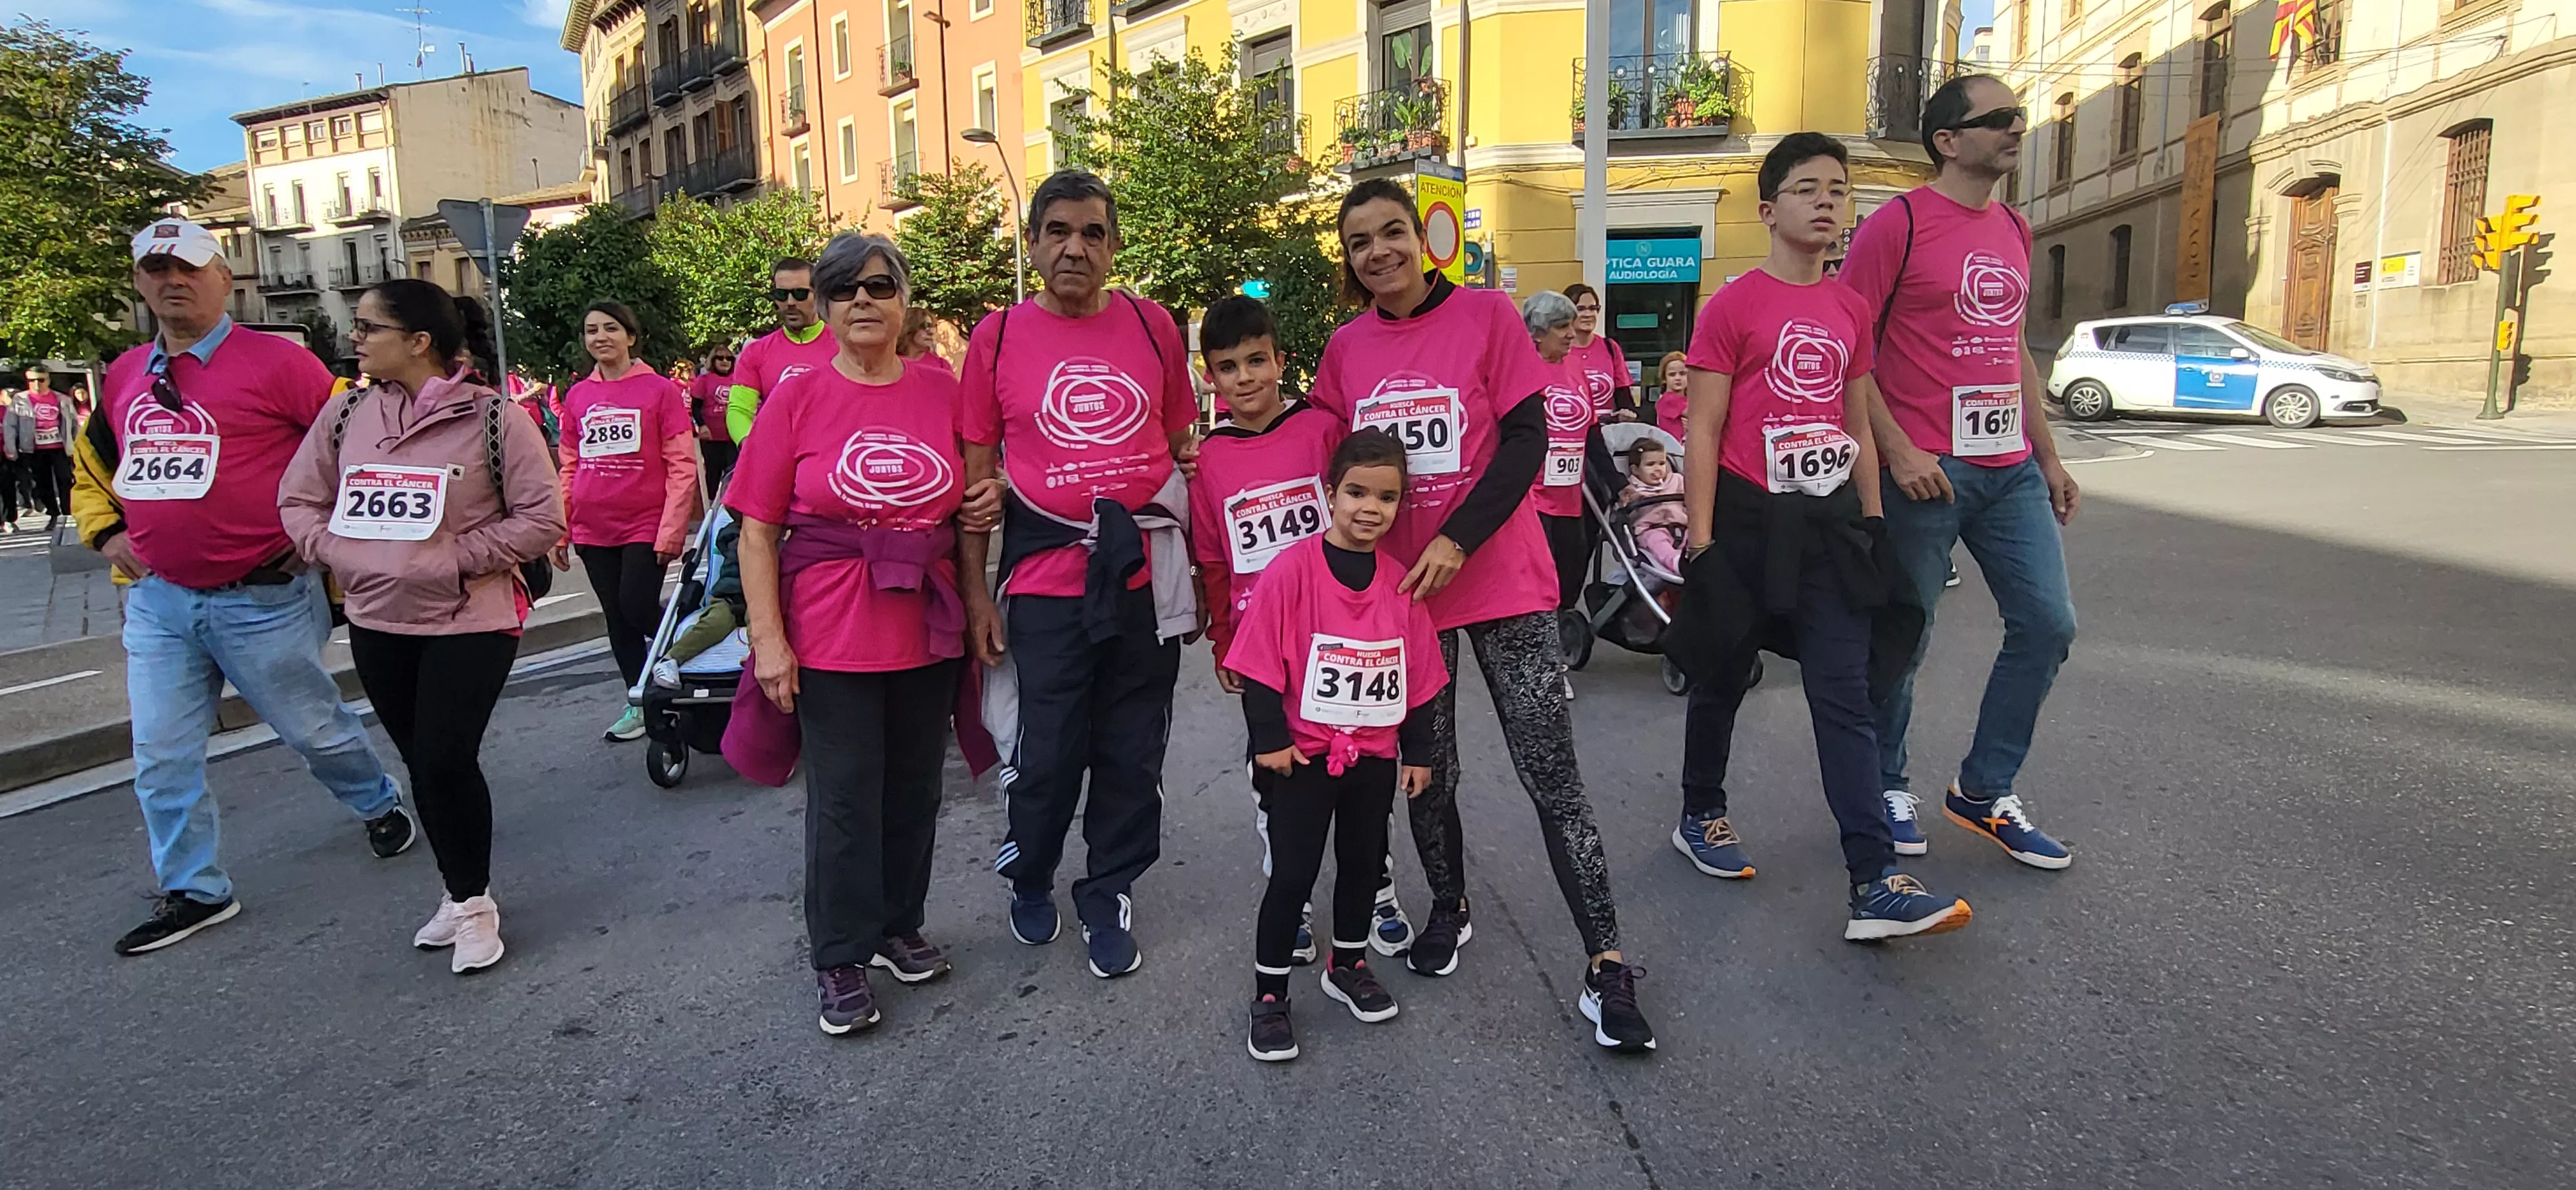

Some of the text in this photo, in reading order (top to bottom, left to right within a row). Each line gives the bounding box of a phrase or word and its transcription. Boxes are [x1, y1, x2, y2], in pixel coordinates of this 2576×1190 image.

[1420, 182, 1462, 198] ATENCIÓN
[1605, 256, 1696, 268] TICA GUARA
[1364, 409, 1397, 420] CONTRA
[1410, 404, 1446, 415] CÁNCER
[1965, 408, 2017, 435] 1697
[585, 424, 633, 444] 2886
[1383, 418, 1448, 450] 150
[1779, 439, 1813, 449] CONTRA
[128, 457, 204, 480] 2664
[1557, 457, 1580, 473] 903
[1779, 444, 1851, 478] 1696
[396, 478, 433, 489] CÁNCER
[346, 490, 432, 519] 2663
[1236, 504, 1268, 518] CONTRA
[1280, 492, 1313, 505] CÁNCER
[1259, 492, 1285, 503] HUESCA
[1238, 505, 1320, 549] 3149
[1323, 653, 1363, 666] CONTRA
[1317, 667, 1399, 702] 3148
